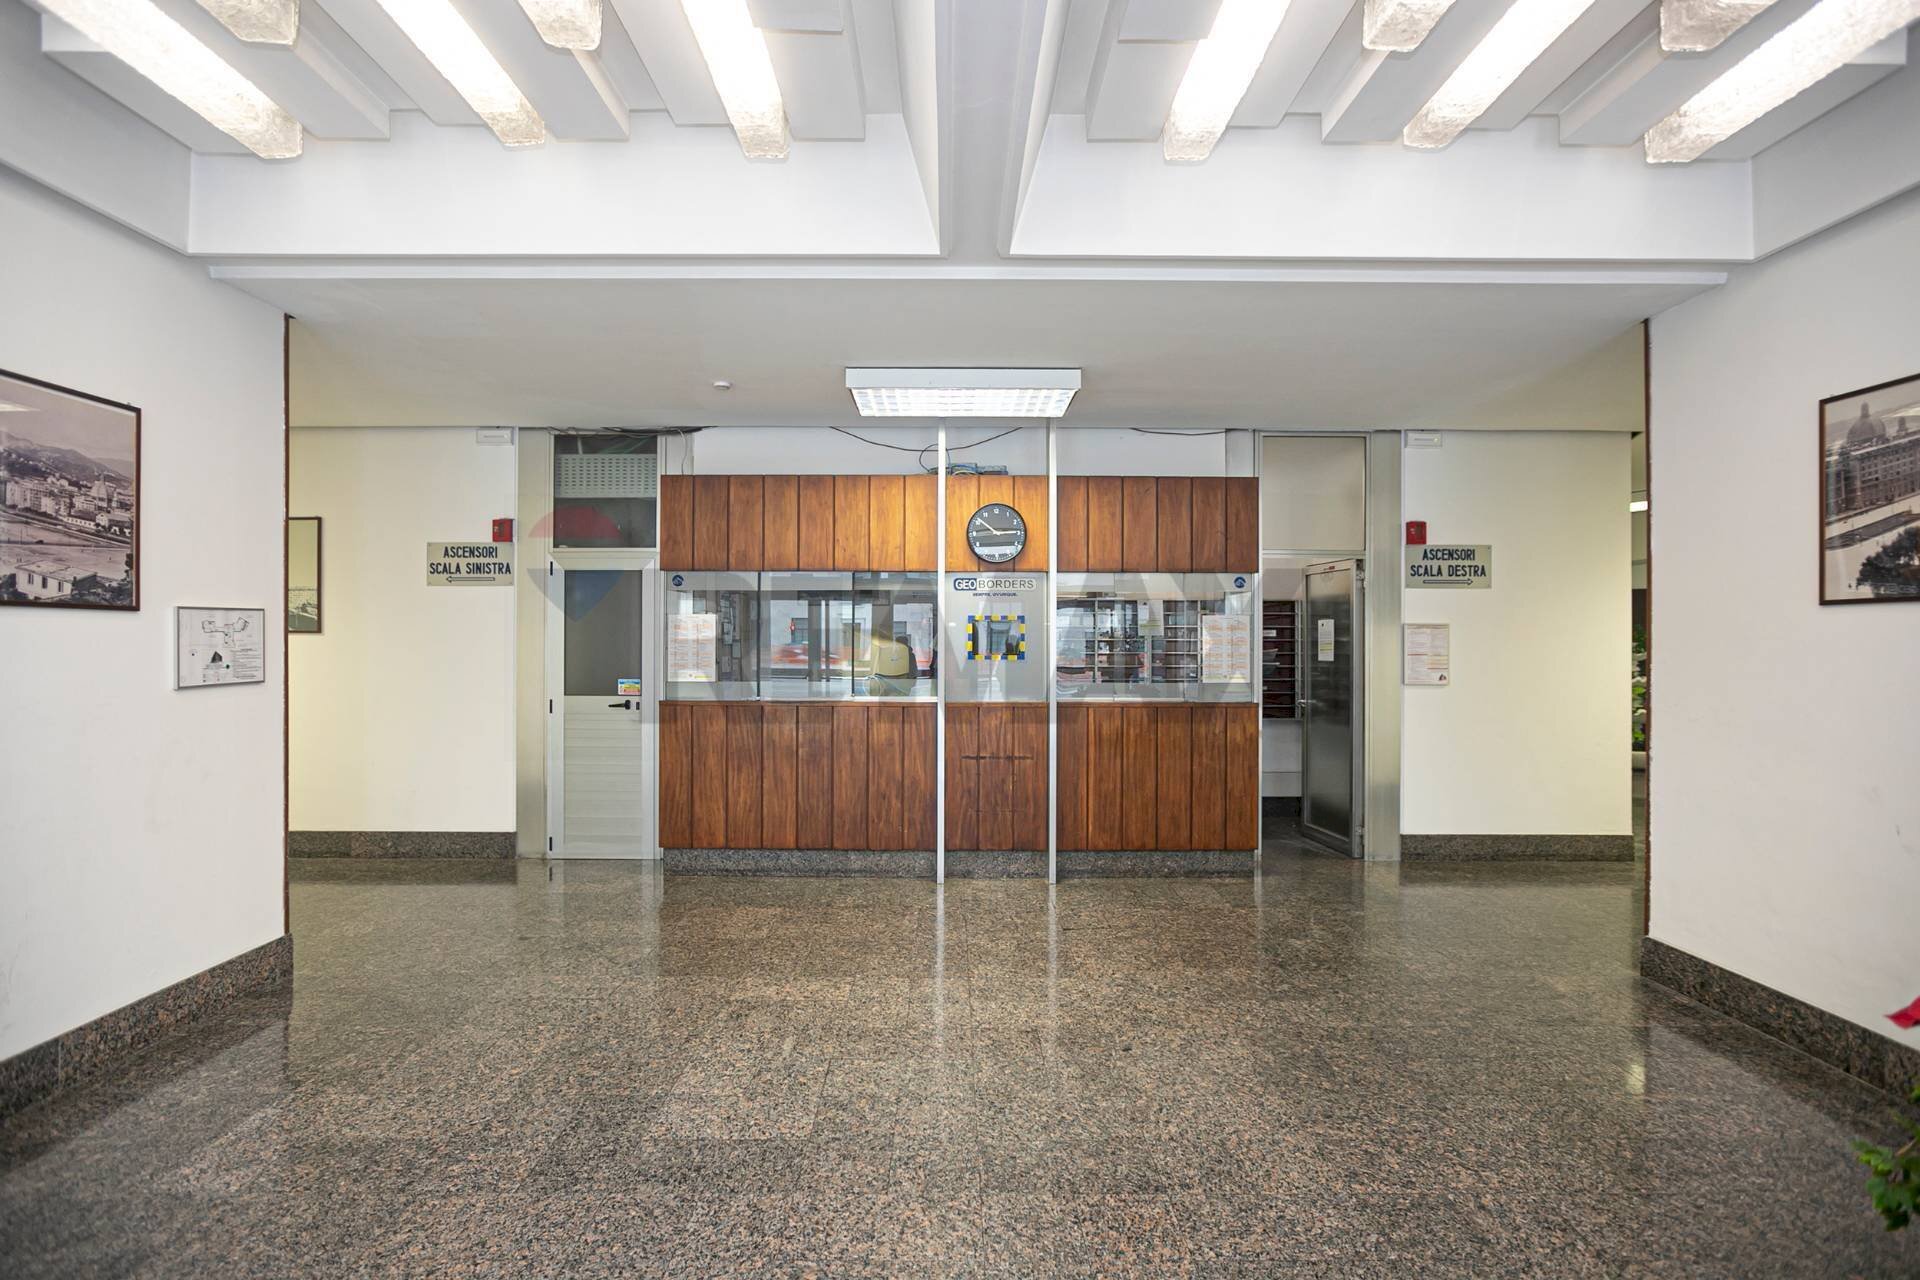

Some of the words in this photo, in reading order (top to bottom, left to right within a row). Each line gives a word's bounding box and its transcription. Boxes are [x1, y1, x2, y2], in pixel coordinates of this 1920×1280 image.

[443, 546, 498, 558] ASCENSORI
[1422, 548, 1476, 561] ASCENSORI
[429, 562, 462, 575] SCALA
[465, 562, 512, 575] SINISTRA
[1410, 564, 1443, 577] SCALA
[1447, 564, 1487, 577] DESTRA
